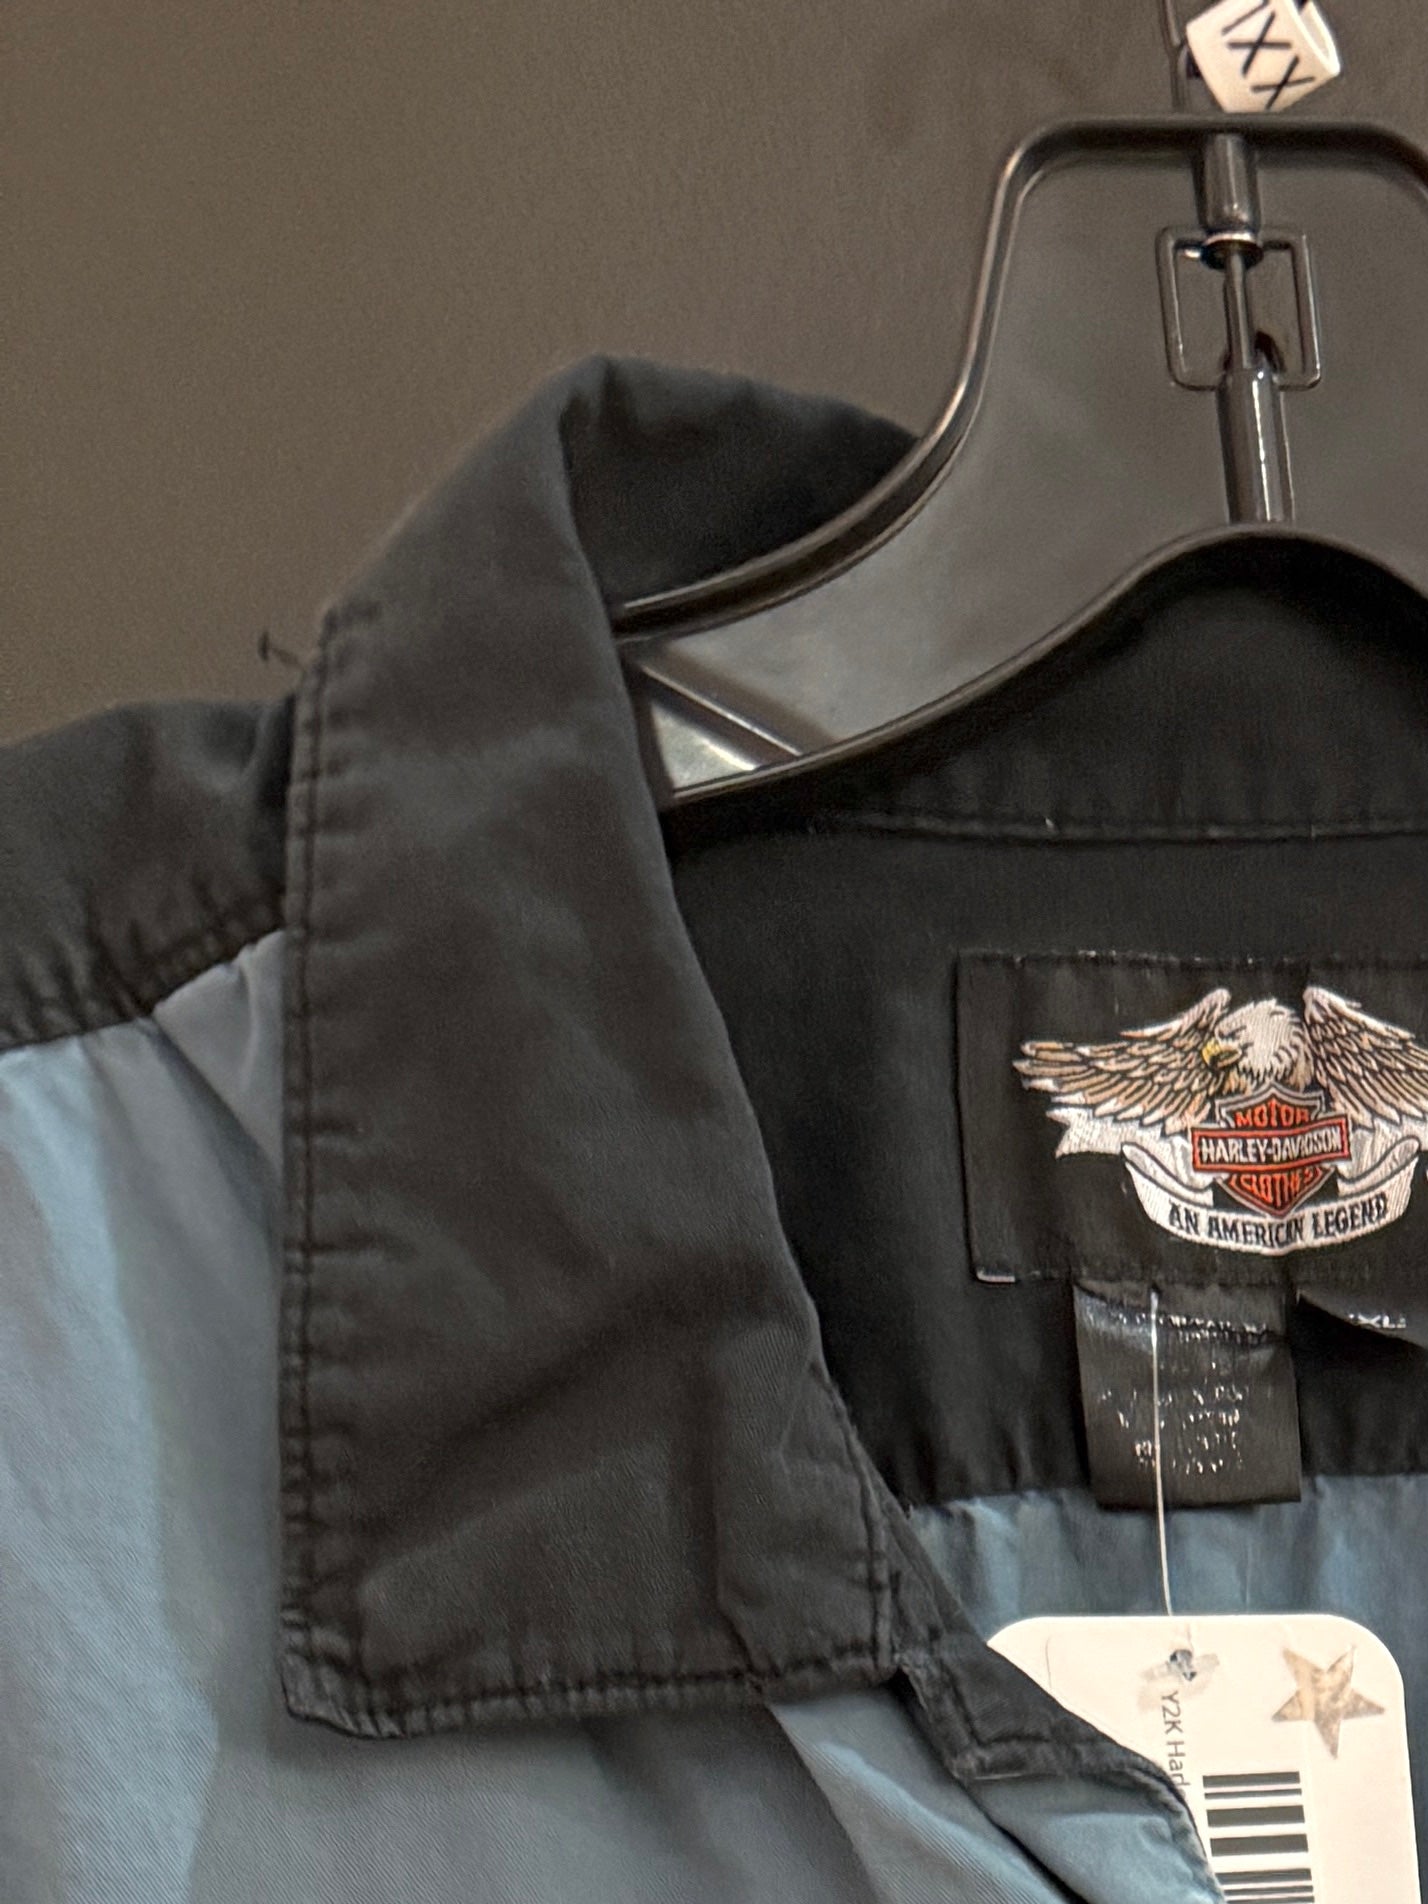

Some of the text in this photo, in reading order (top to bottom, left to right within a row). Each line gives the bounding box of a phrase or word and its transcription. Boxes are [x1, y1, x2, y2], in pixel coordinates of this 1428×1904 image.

[1235, 1099, 1309, 1129] MOTOR
[1200, 1124, 1343, 1163] HARLEY-DAVIDSON
[1168, 1203, 1200, 1234] AN
[1312, 1192, 1389, 1238] LEGEND
[1161, 1690, 1184, 1734] Y2K
